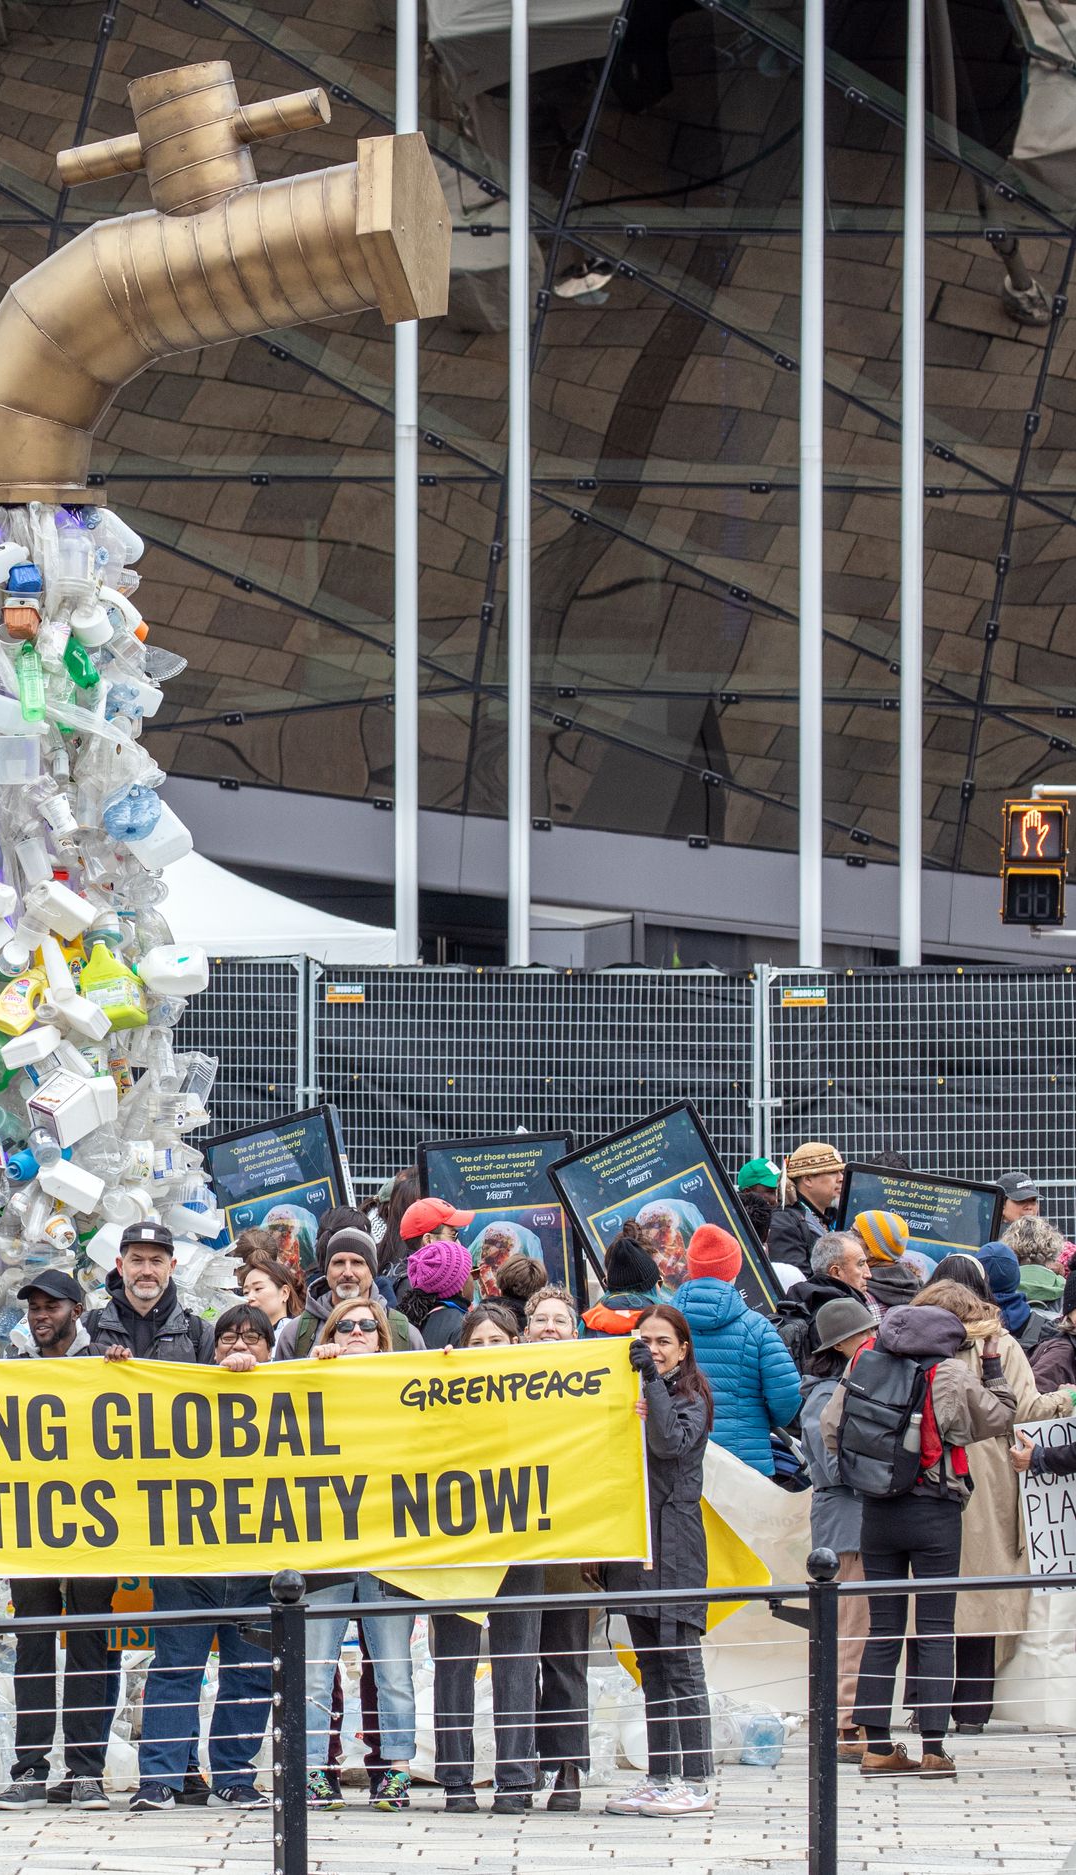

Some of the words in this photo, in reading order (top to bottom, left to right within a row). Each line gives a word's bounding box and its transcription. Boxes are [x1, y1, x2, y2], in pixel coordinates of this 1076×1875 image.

[257, 1138, 275, 1148] those
[276, 1128, 306, 1143] essential
[601, 1148, 610, 1156] of
[610, 1138, 631, 1151] those
[632, 1120, 666, 1142] essential
[238, 1140, 301, 1164] state-of-our-world
[484, 1152, 505, 1160] those
[507, 1149, 542, 1159] essential
[591, 1133, 663, 1172] state-of-our-world
[249, 1171, 265, 1180] Owen
[460, 1160, 535, 1173] state-of-our-world
[608, 1174, 627, 1184] Owen
[884, 1188, 962, 1205] state-of-our-world
[910, 1182, 933, 1191] those
[934, 1187, 972, 1197] essential
[890, 1208, 909, 1217] Owen
[400, 1368, 611, 1411] GREENPEACE
[92, 1391, 341, 1460] GLOBAL
[137, 1474, 368, 1546] TREATY
[391, 1465, 552, 1538] NOW!
